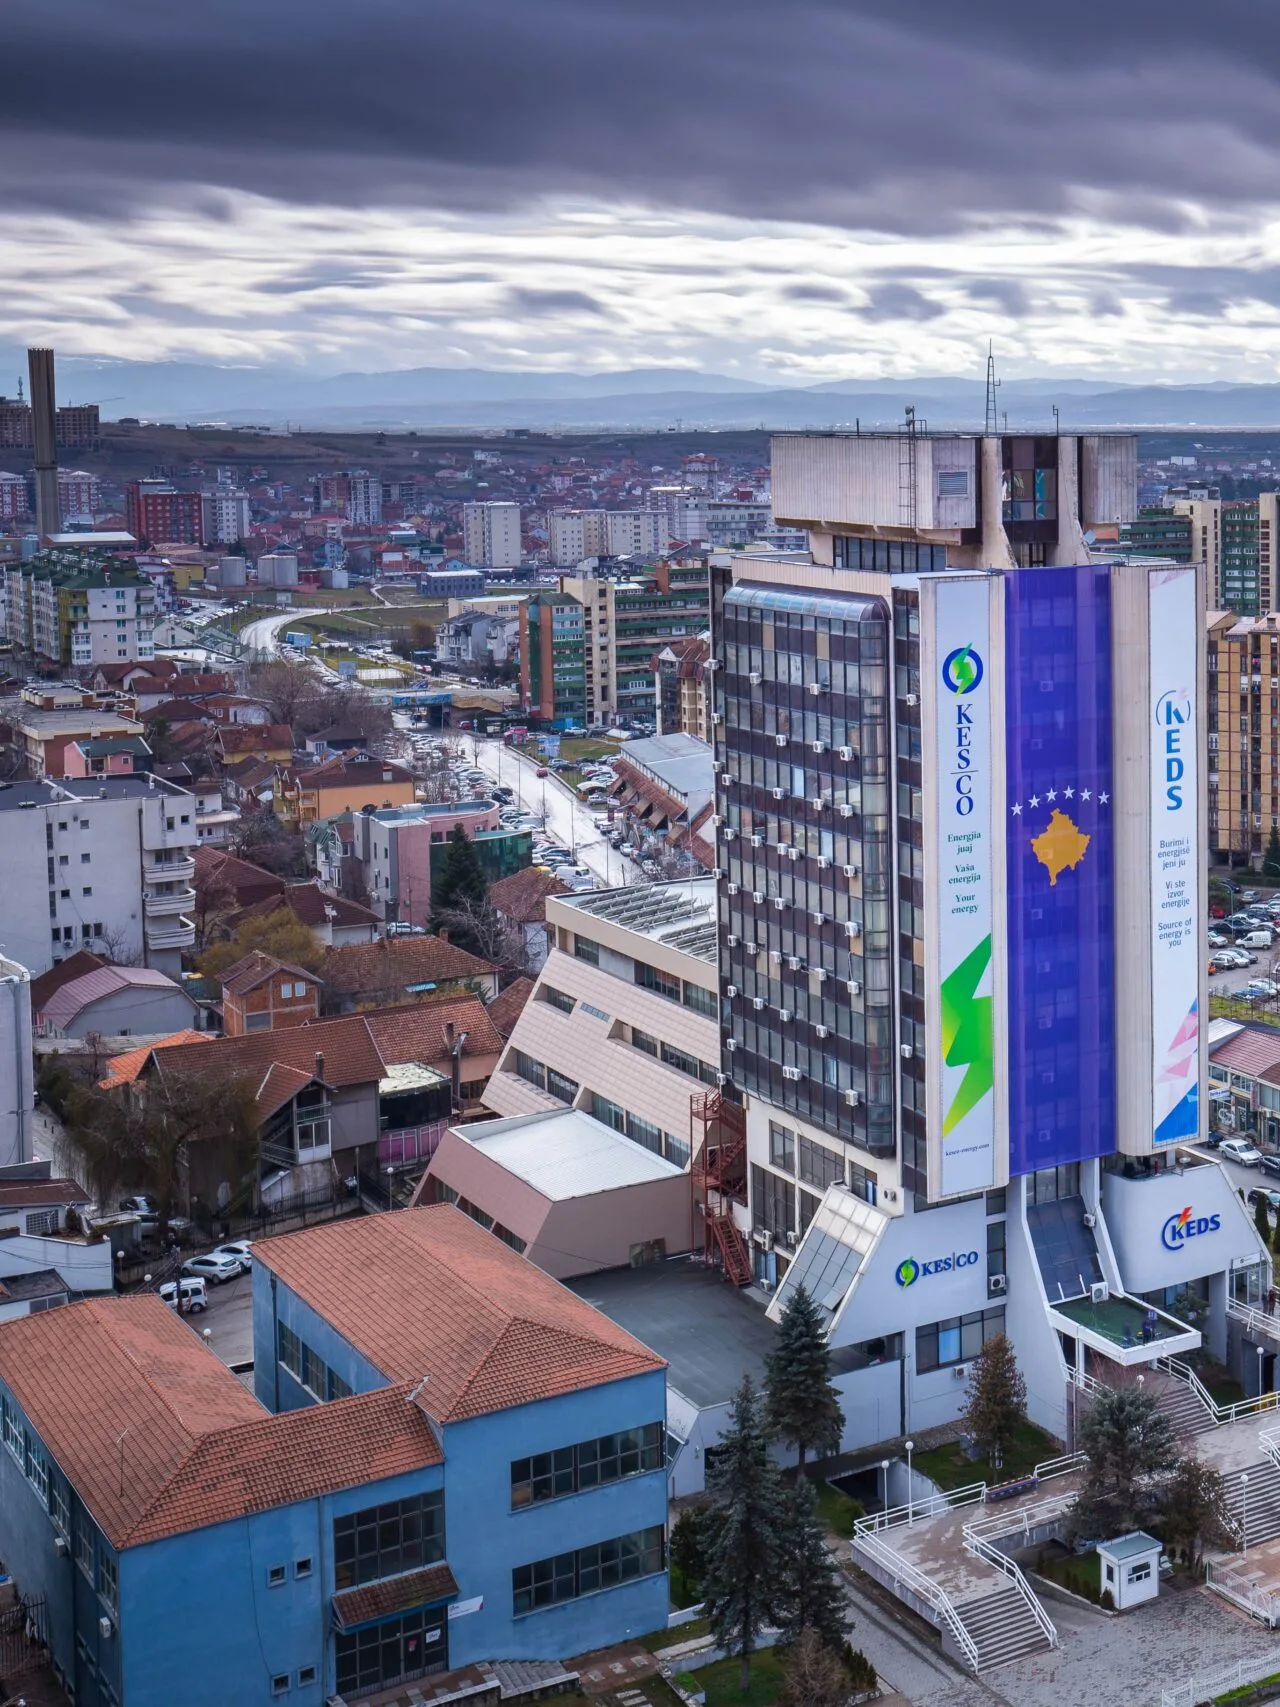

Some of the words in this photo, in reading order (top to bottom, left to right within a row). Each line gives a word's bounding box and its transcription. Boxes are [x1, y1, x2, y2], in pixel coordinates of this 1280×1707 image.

[947, 831, 981, 843] Energjia
[957, 844, 973, 855] juaj
[1159, 839, 1185, 849] Burimi
[955, 863, 975, 873] Vaša
[1162, 860, 1176, 870] jeni
[1178, 859, 1186, 868] ju
[948, 873, 981, 884] energija
[1165, 881, 1173, 889] Vi
[1174, 880, 1186, 888] ste
[955, 894, 976, 902] Your
[1167, 890, 1184, 899] izvor
[1161, 897, 1190, 909] energije
[951, 904, 978, 914] energy
[1158, 920, 1183, 931] Source
[1184, 917, 1192, 926] of
[1159, 929, 1183, 940] energy
[1184, 928, 1191, 936] is
[1168, 940, 1182, 949] you
[1170, 1213, 1222, 1242] KEDS
